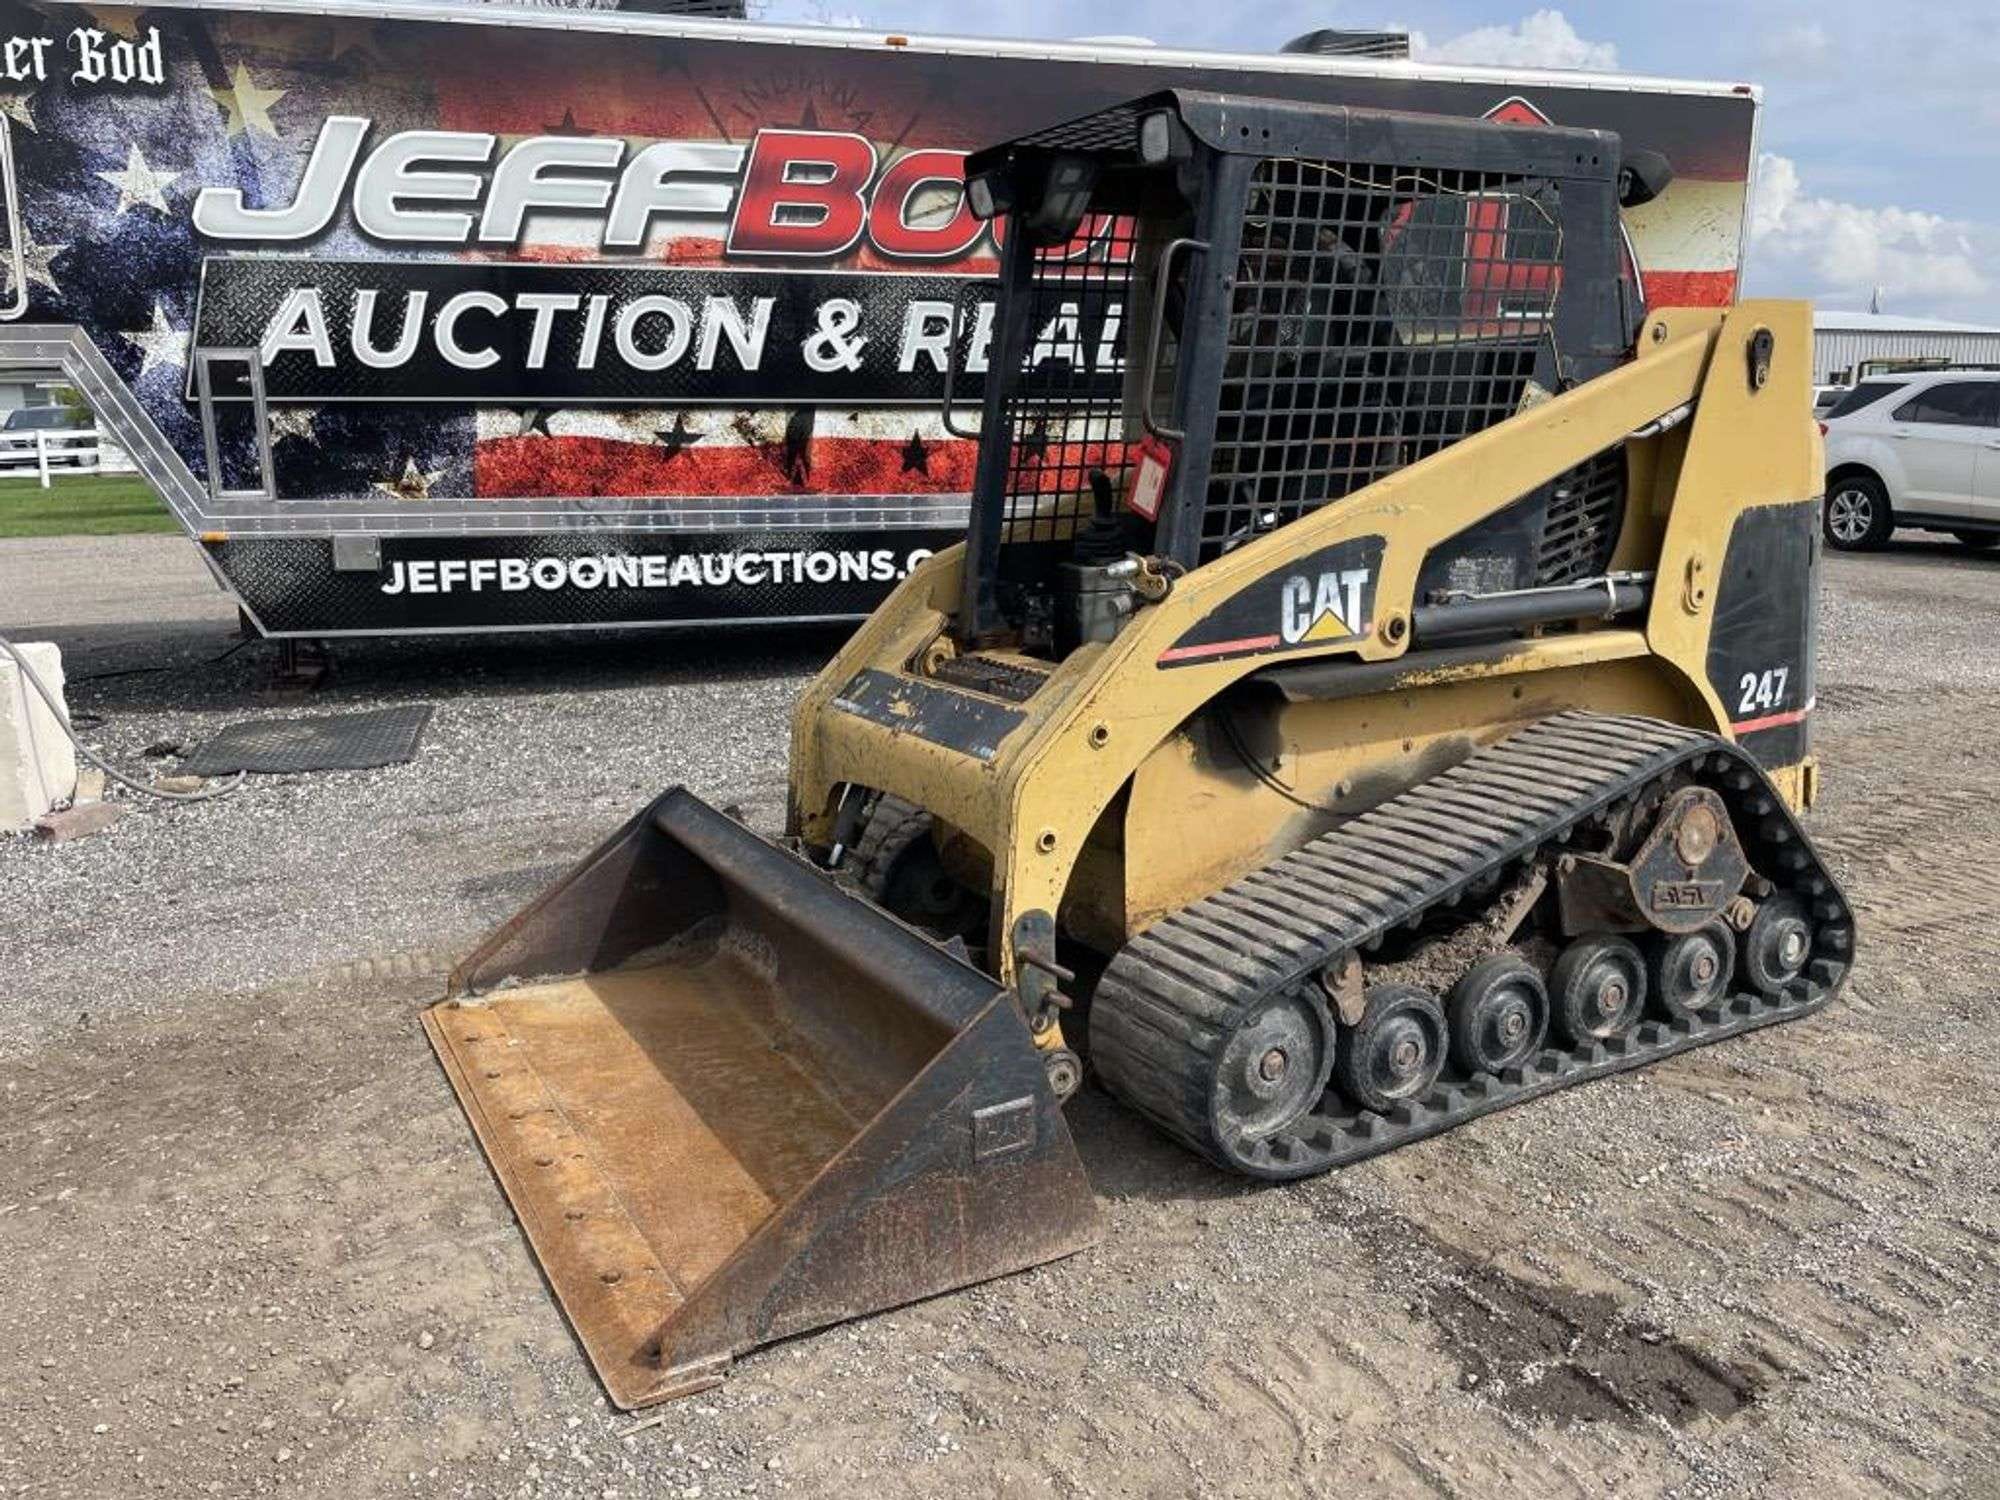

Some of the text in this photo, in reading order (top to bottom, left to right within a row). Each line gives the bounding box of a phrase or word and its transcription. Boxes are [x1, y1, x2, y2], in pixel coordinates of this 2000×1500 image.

[0, 36, 54, 81] er
[262, 288, 777, 372] AUCTION
[802, 298, 868, 372] &
[1281, 568, 1370, 643] CAT
[1739, 667, 1789, 714] 247
